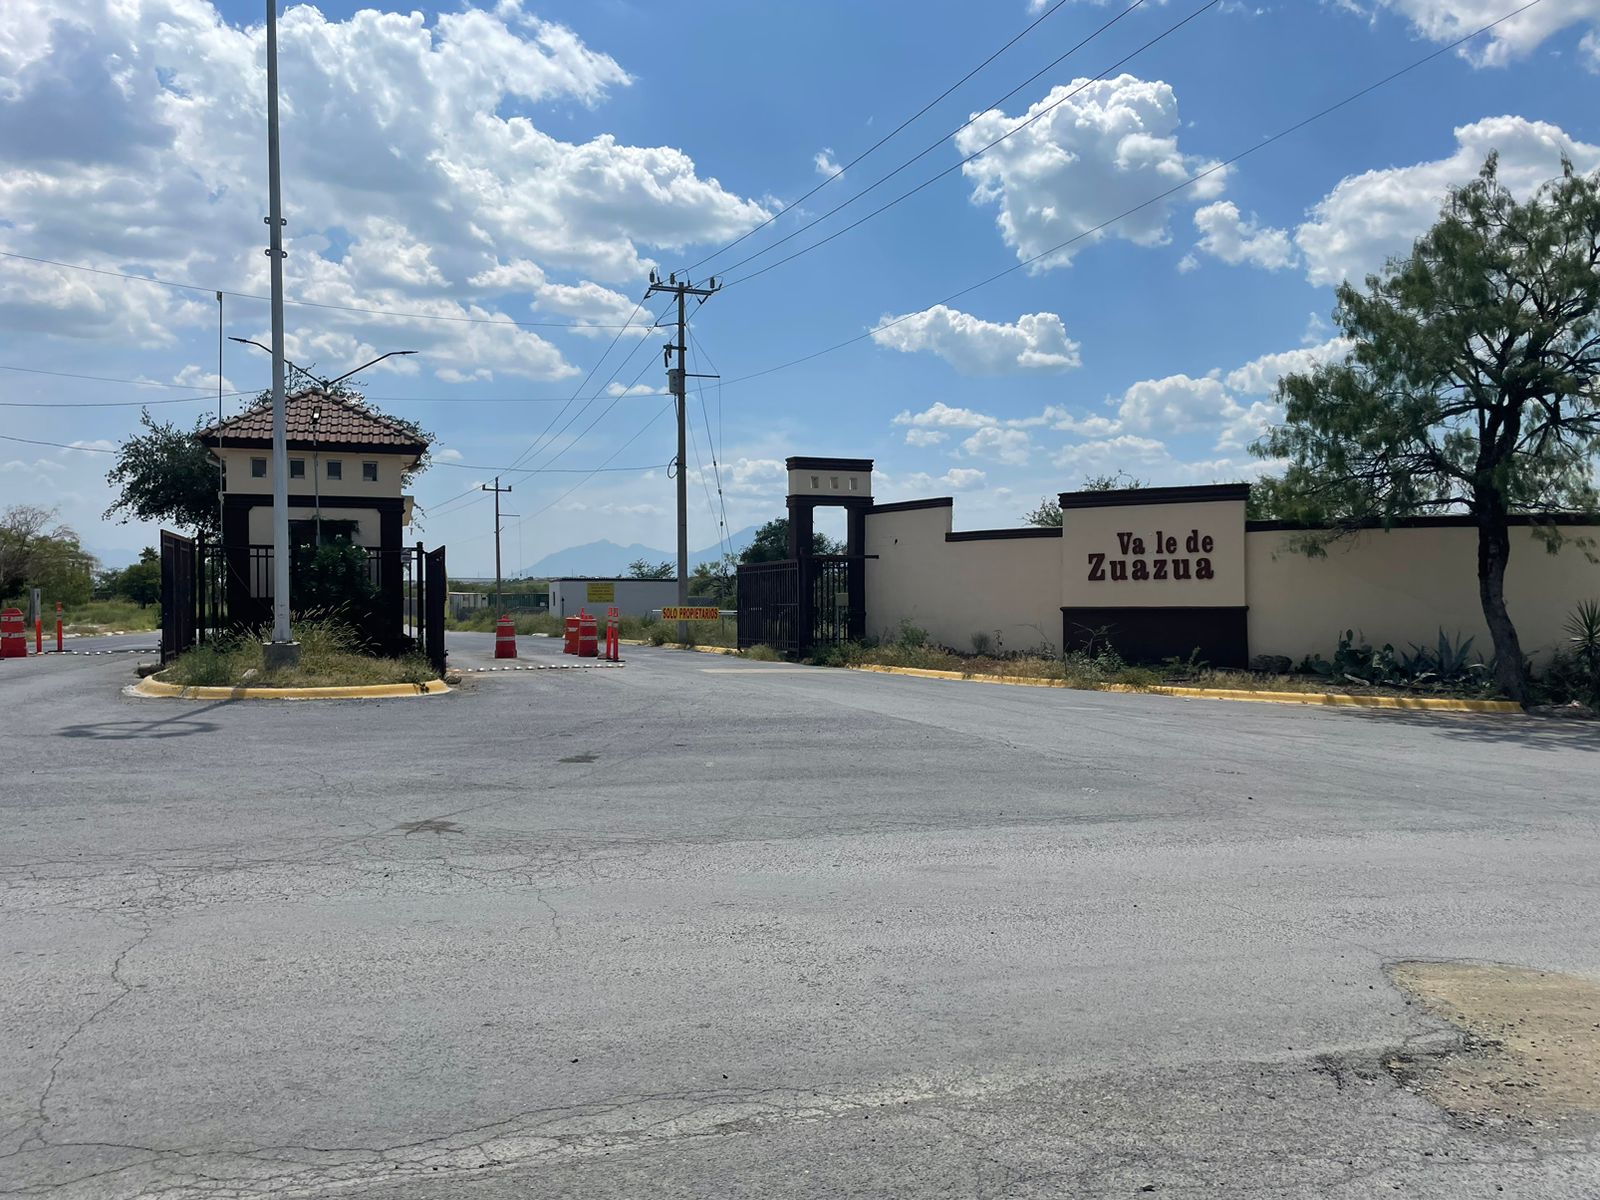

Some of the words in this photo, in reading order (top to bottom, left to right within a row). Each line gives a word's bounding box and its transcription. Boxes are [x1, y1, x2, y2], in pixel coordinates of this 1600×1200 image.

[1186, 529, 1214, 553] de
[1088, 553, 1214, 581] Zuazua
[663, 607, 677, 619] SOLO
[679, 607, 718, 619] PROPIETARIOS
